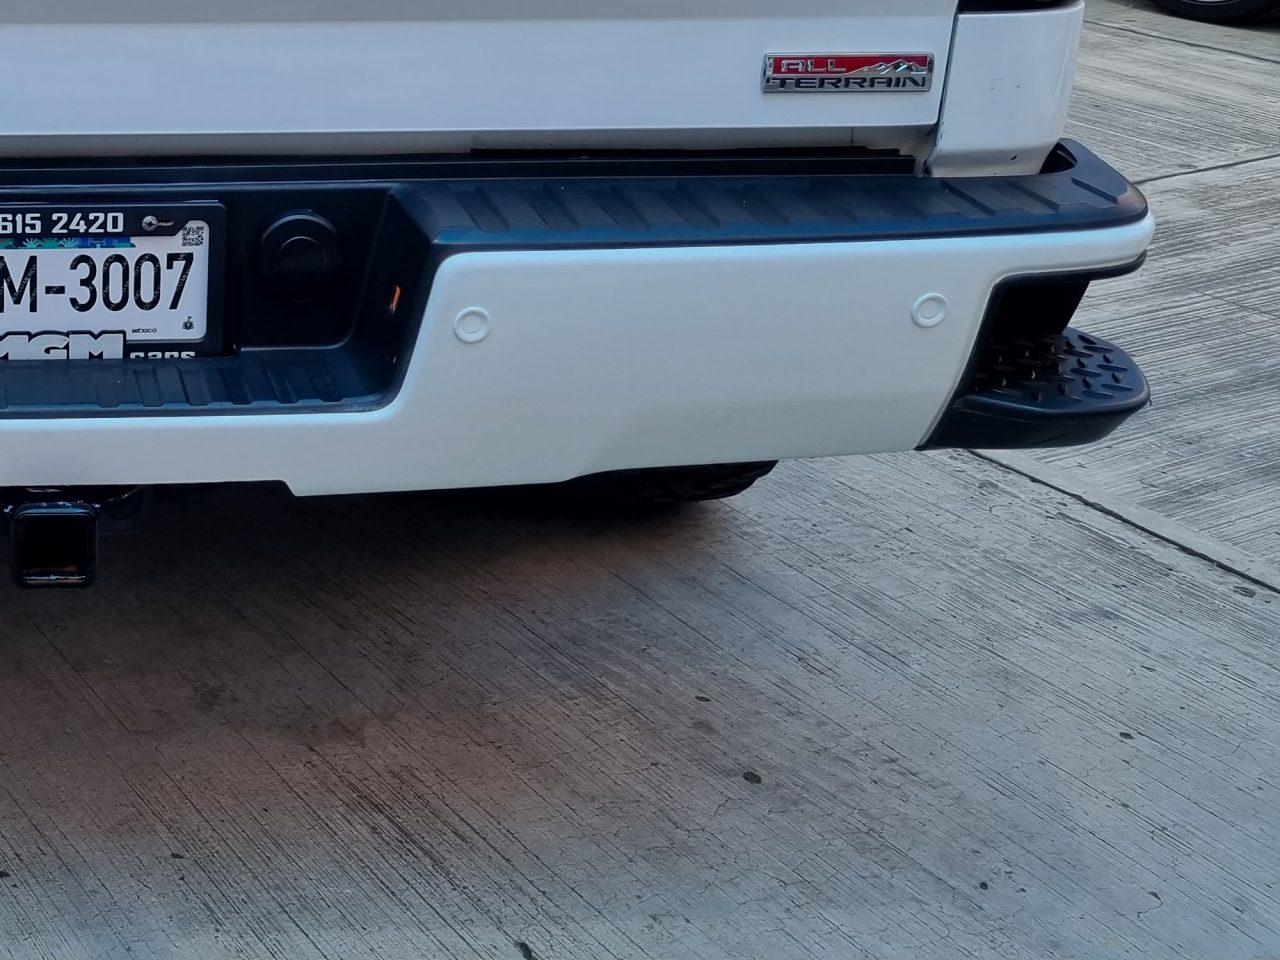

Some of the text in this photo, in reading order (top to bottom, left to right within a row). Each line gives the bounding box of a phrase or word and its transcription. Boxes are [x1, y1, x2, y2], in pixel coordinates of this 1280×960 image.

[780, 59, 846, 73] ALL
[766, 77, 925, 89] TERRAIN
[51, 212, 124, 233] 2420
